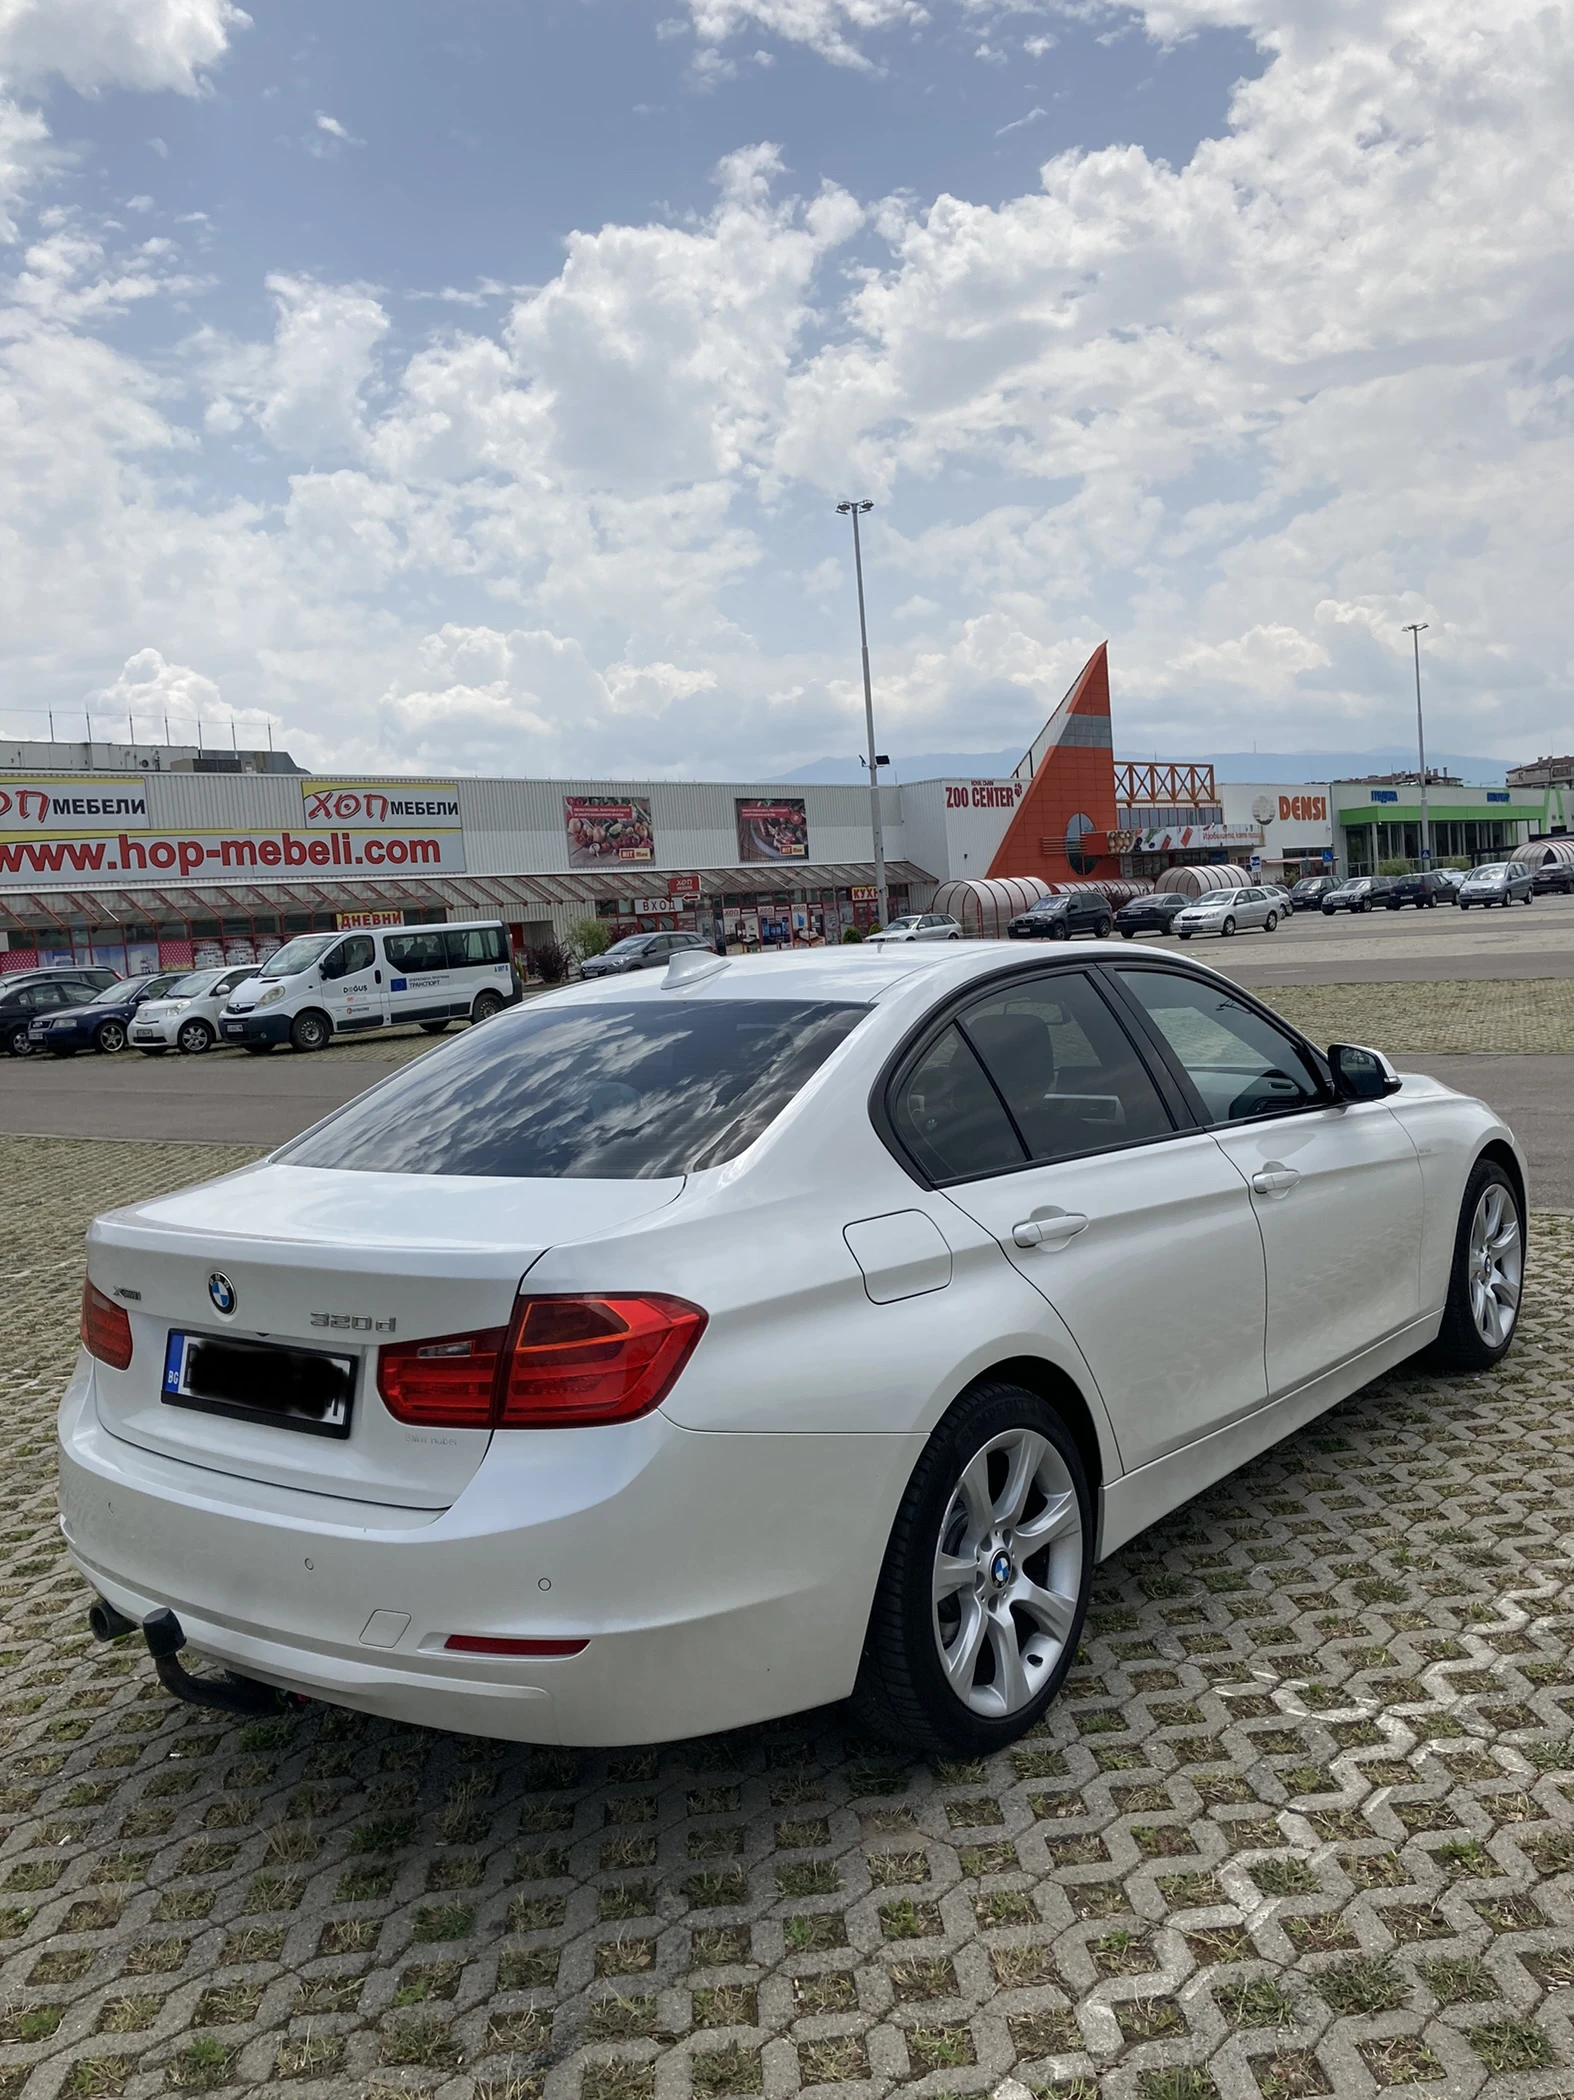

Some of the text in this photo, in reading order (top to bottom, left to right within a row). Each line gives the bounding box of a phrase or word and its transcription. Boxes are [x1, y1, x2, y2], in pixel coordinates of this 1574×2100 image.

[53, 799, 146, 815] МЕБЕЛИ
[307, 792, 459, 822] ХОП МЕБЕЛИ
[945, 787, 1014, 808] ZOO CENTER
[1278, 796, 1327, 820] DENSI
[0, 833, 441, 876] www.hop-mebeli.com
[643, 900, 676, 911] ВХОД
[341, 913, 402, 929] ДНЕВНИ
[310, 1311, 396, 1332] 320d
[168, 1370, 180, 1385] BG
